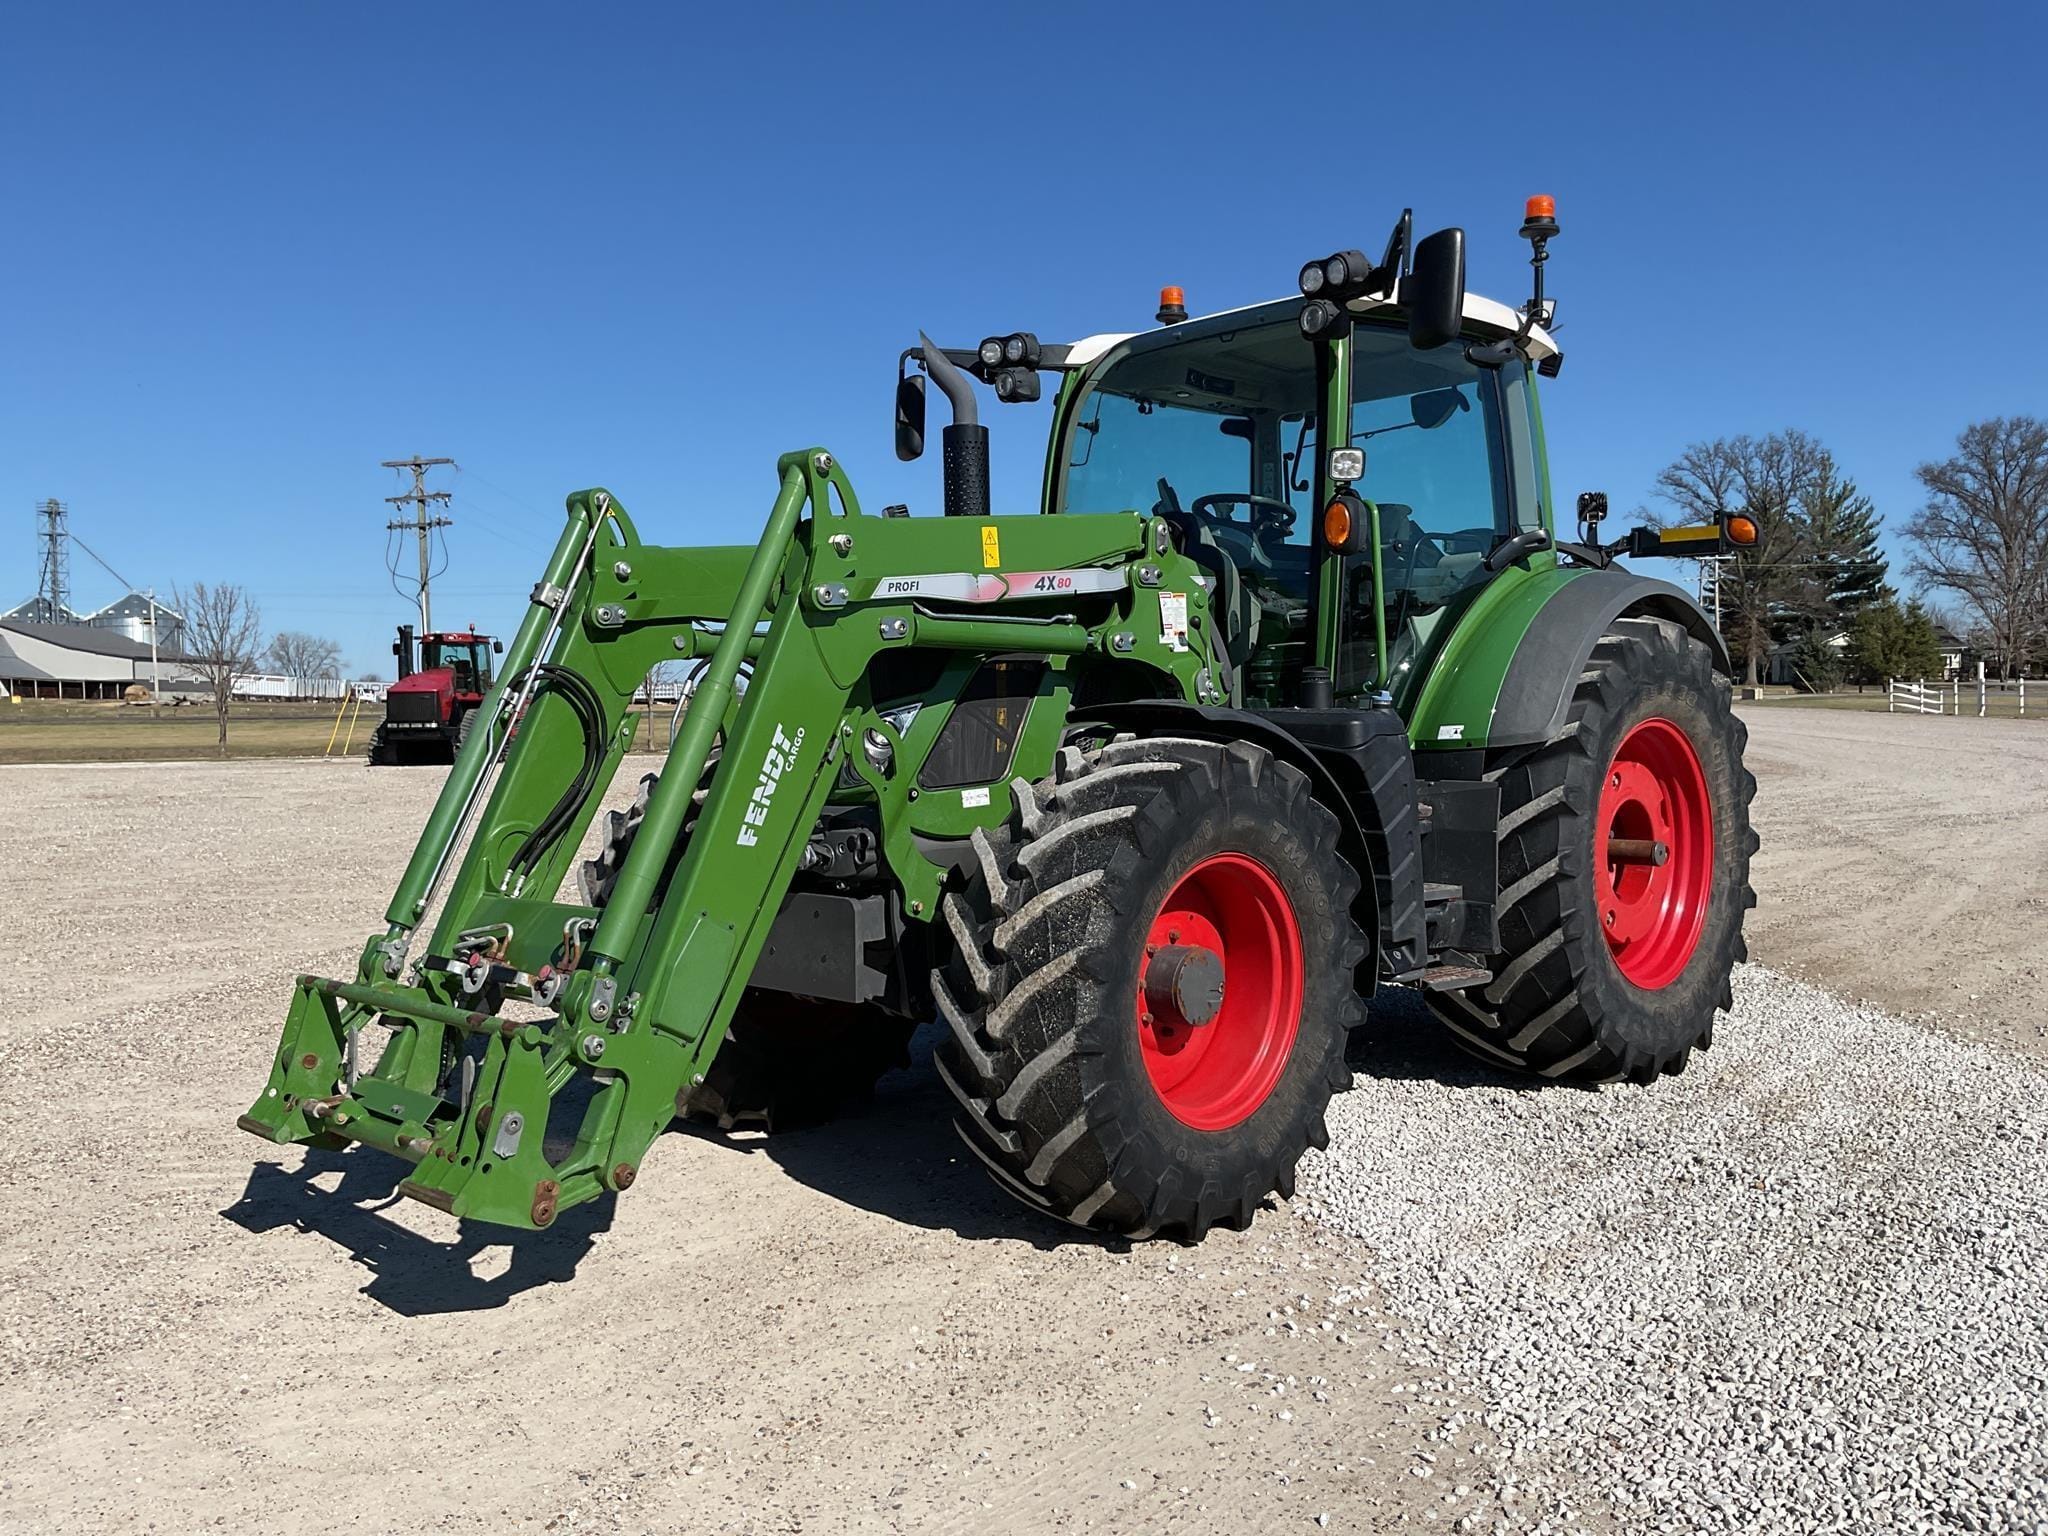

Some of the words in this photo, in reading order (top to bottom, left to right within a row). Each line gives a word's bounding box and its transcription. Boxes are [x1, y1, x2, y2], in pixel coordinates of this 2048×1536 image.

[888, 581, 919, 592] PROFI
[785, 727, 805, 772] CARGO
[736, 722, 791, 846] FENDT
